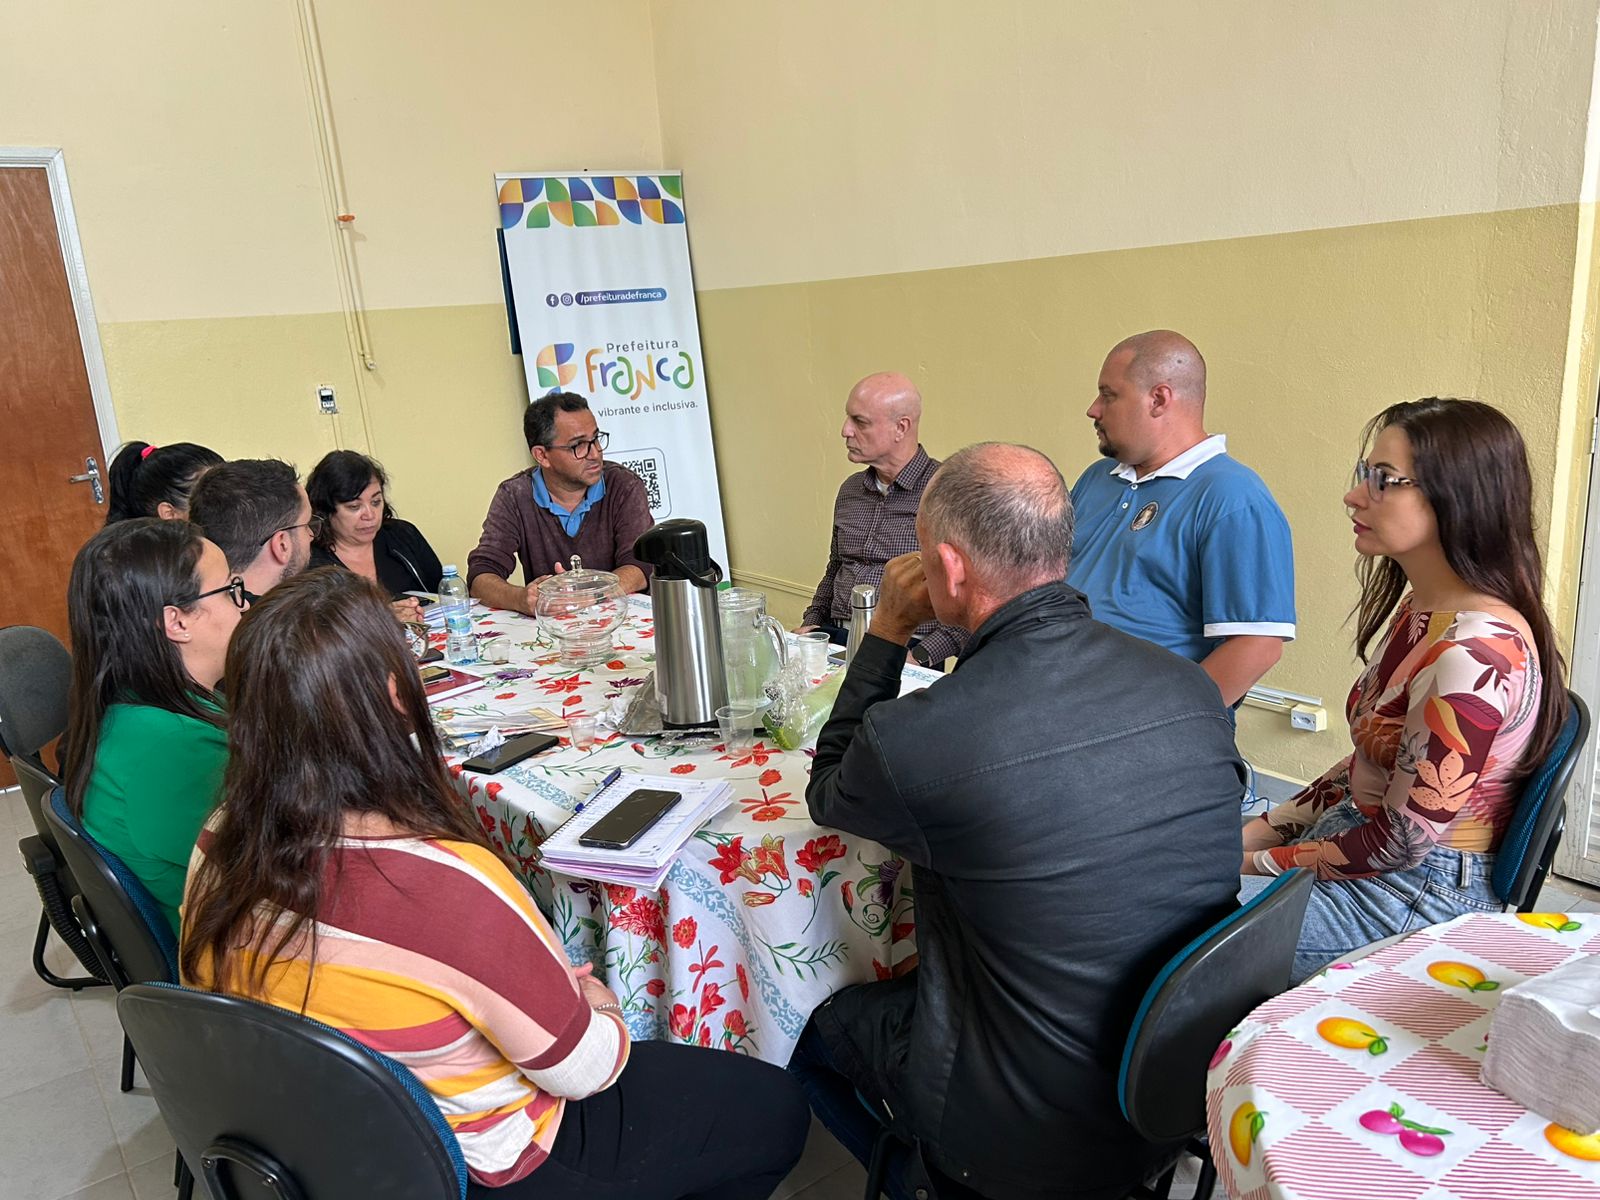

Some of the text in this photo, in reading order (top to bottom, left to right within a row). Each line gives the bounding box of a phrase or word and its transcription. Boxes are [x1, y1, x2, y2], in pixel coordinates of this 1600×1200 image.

[580, 291, 662, 305] /prefeituradefranca
[606, 340, 679, 353] Prefeitura
[598, 400, 698, 417] vibrante e inclusiva.
